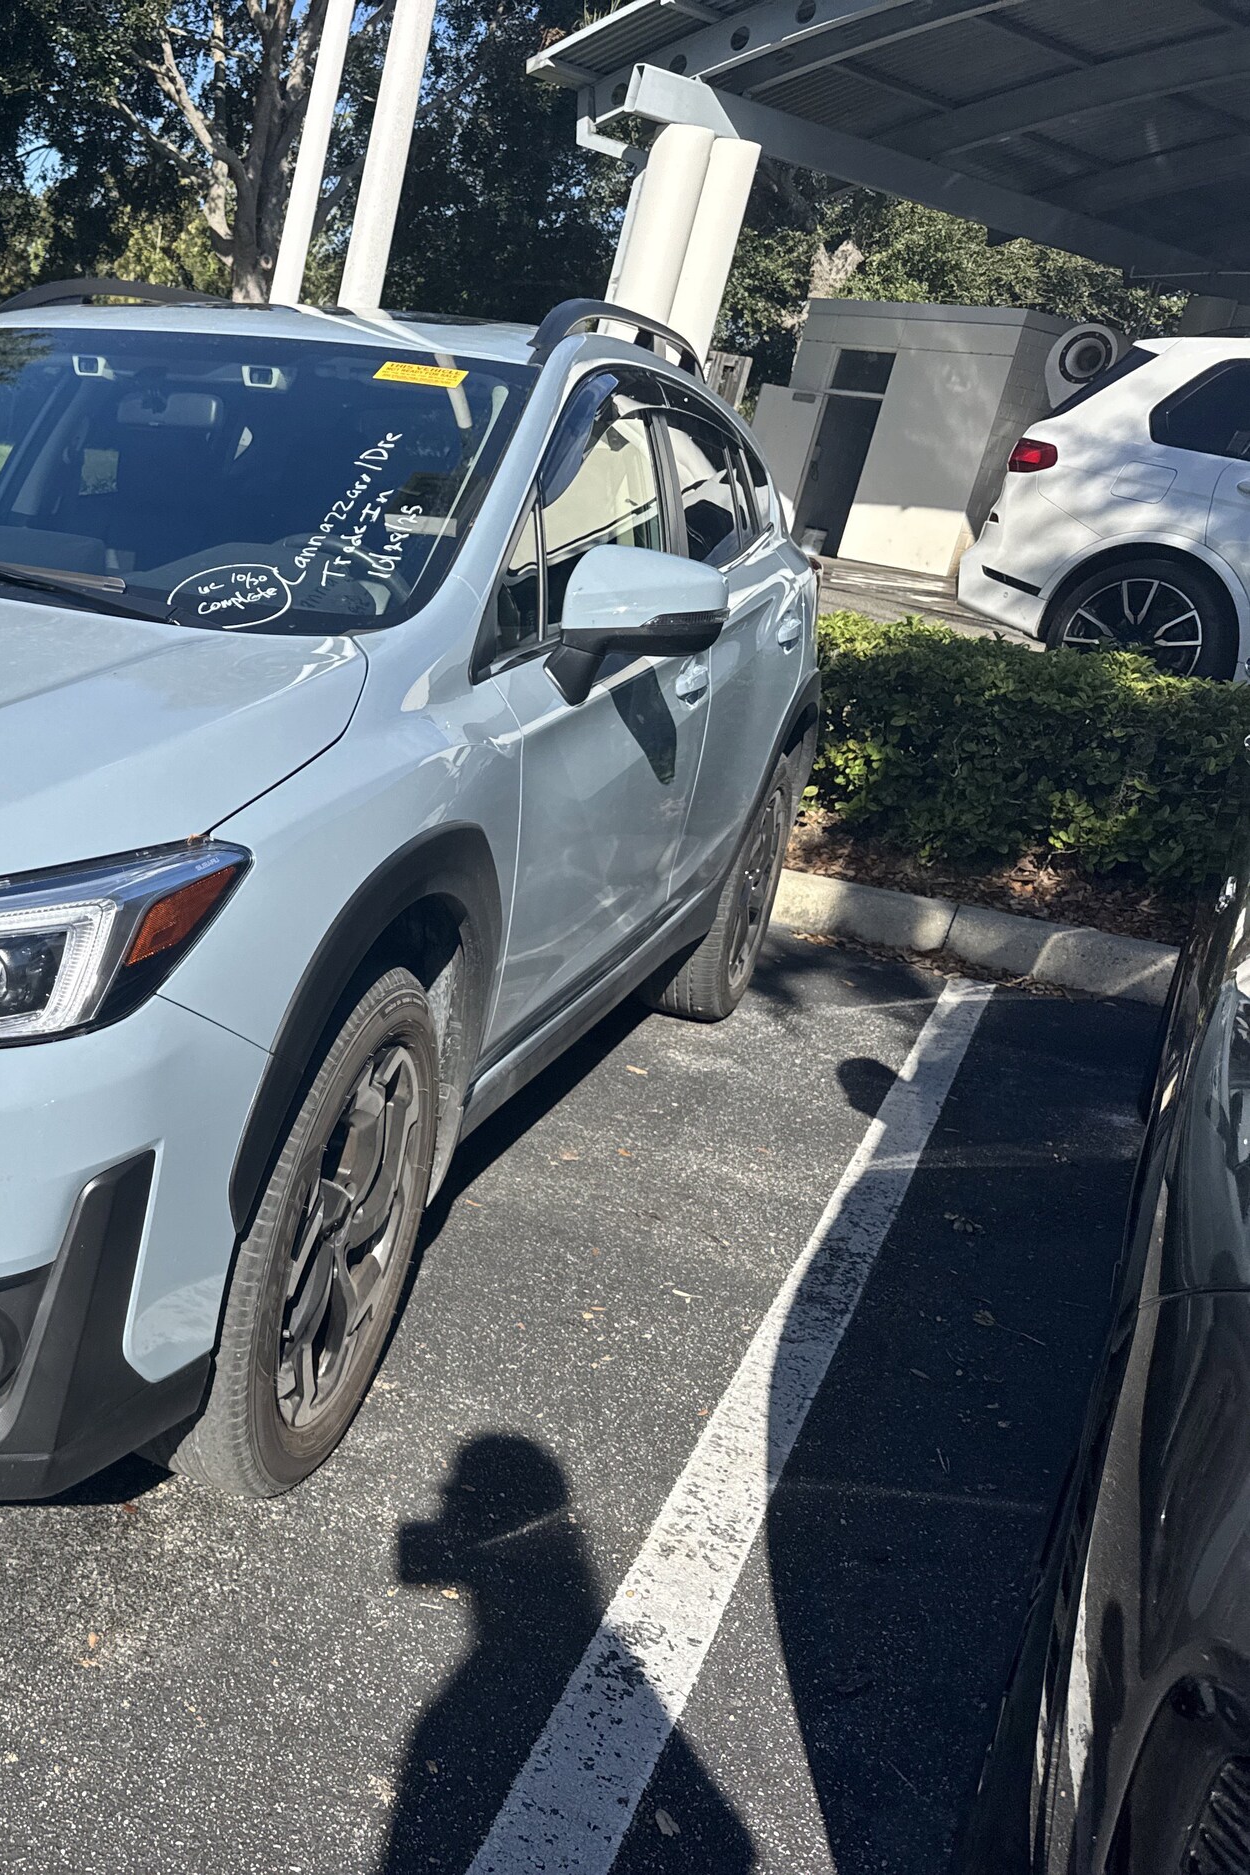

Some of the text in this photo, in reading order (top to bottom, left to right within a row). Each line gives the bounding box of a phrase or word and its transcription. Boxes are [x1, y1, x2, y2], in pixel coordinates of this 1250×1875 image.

[416, 366, 461, 376] VEHICLE
[367, 504, 423, 578] 10/28/25
[195, 857, 220, 871] SUBARU
